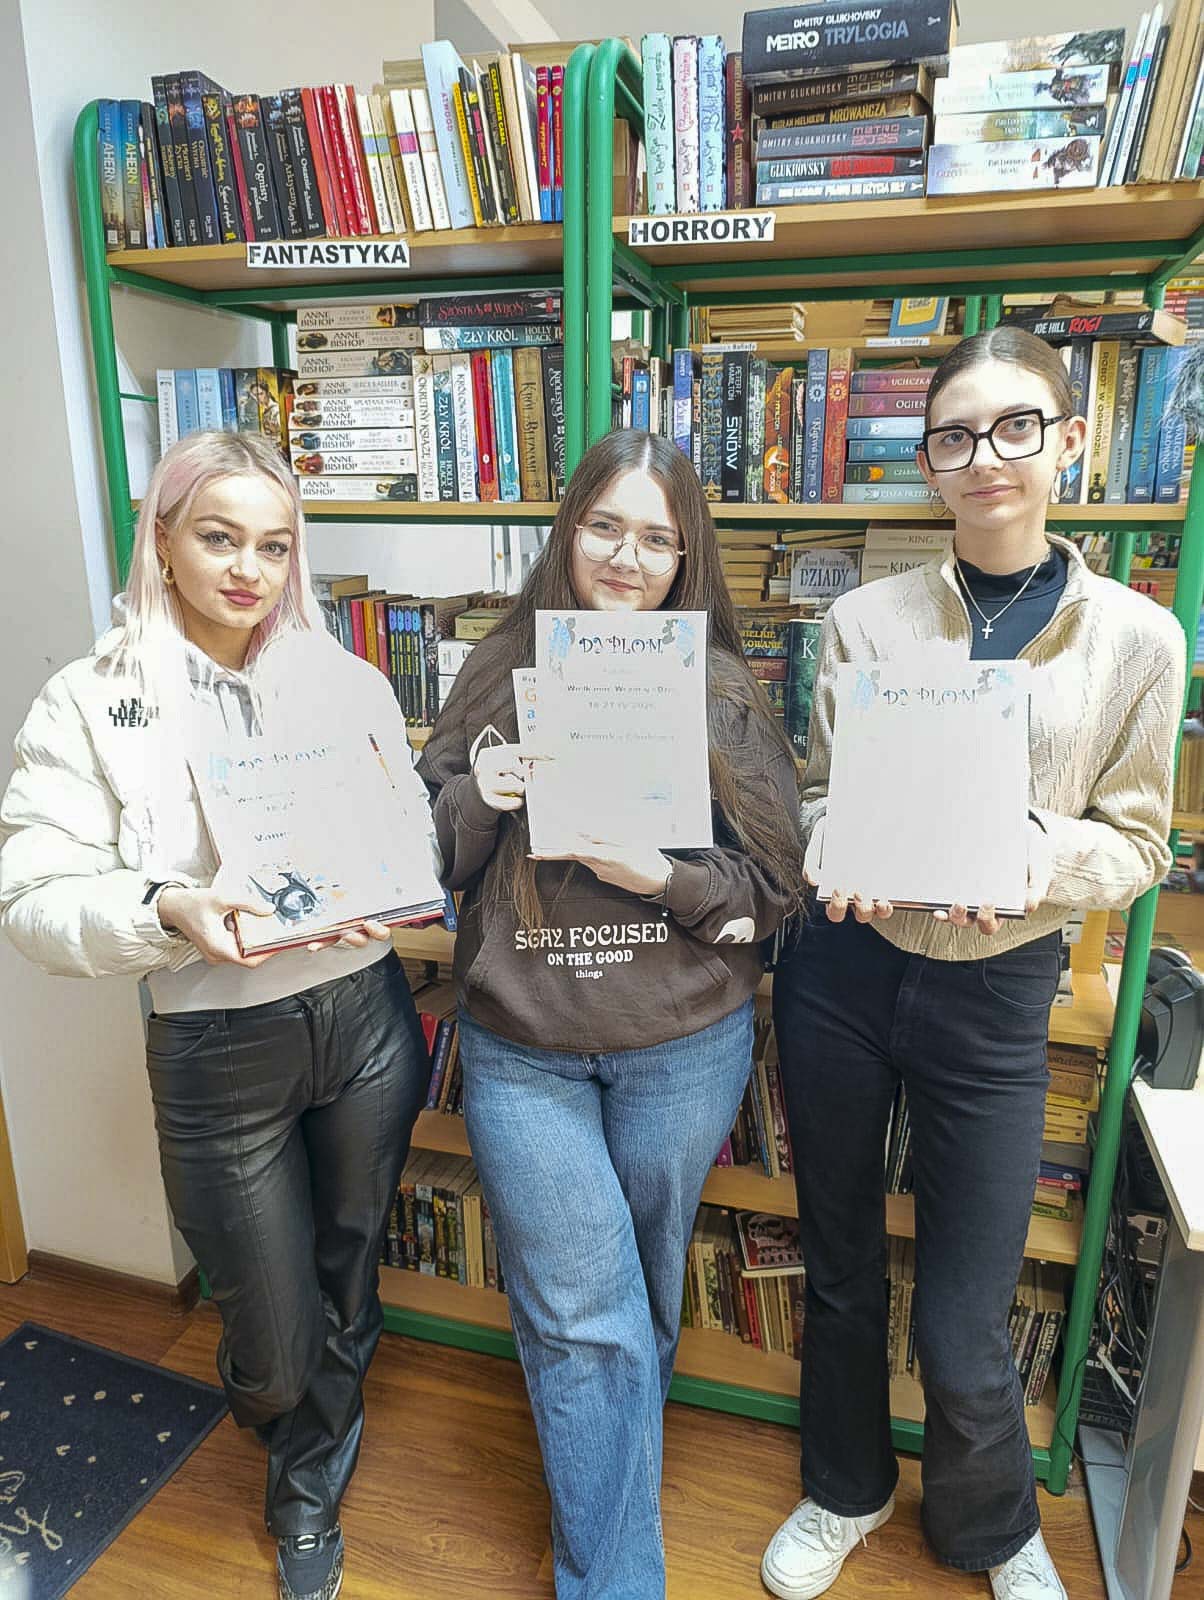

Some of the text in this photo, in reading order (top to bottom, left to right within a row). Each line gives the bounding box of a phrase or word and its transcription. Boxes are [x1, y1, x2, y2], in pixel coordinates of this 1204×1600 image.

[794, 9, 882, 28] DMITRY GLUKHOVSKY
[766, 20, 909, 52] METRO TRYLOGIA
[759, 82, 842, 104] DMITRY GLUKHOVSKY
[441, 92, 453, 132] ATWOOD
[494, 92, 502, 121] BARKER
[795, 133, 847, 146] GLUKHOVSKY
[103, 142, 116, 185] AHERN
[125, 142, 137, 185] AHERN
[770, 161, 826, 177] GLUKHOVSKY
[255, 163, 269, 202] Ognisty
[631, 216, 771, 242] HORRORY
[249, 243, 408, 265] FANTASTYKA
[301, 319, 334, 327] BISHOP
[525, 326, 552, 334] HOLLY
[1033, 316, 1103, 335] JOE HILL ROGI
[334, 331, 361, 339] ANNE
[463, 329, 518, 343] ZŁY KRÓL
[302, 365, 334, 373] BISHOP
[304, 357, 328, 365] ANNE
[417, 377, 431, 423] OKRUTNY
[519, 382, 537, 410] KRÓL
[438, 395, 452, 454] ZŁY KRÓL
[322, 440, 355, 448] BISHOP
[726, 416, 741, 470] SNÓW
[303, 487, 335, 495] BISHOP
[907, 535, 934, 544] KING
[800, 567, 850, 587] DZIADY
[515, 922, 668, 950] STAY FOCUSED
[547, 950, 633, 966] ON THE GOOD
[575, 970, 603, 979] things
